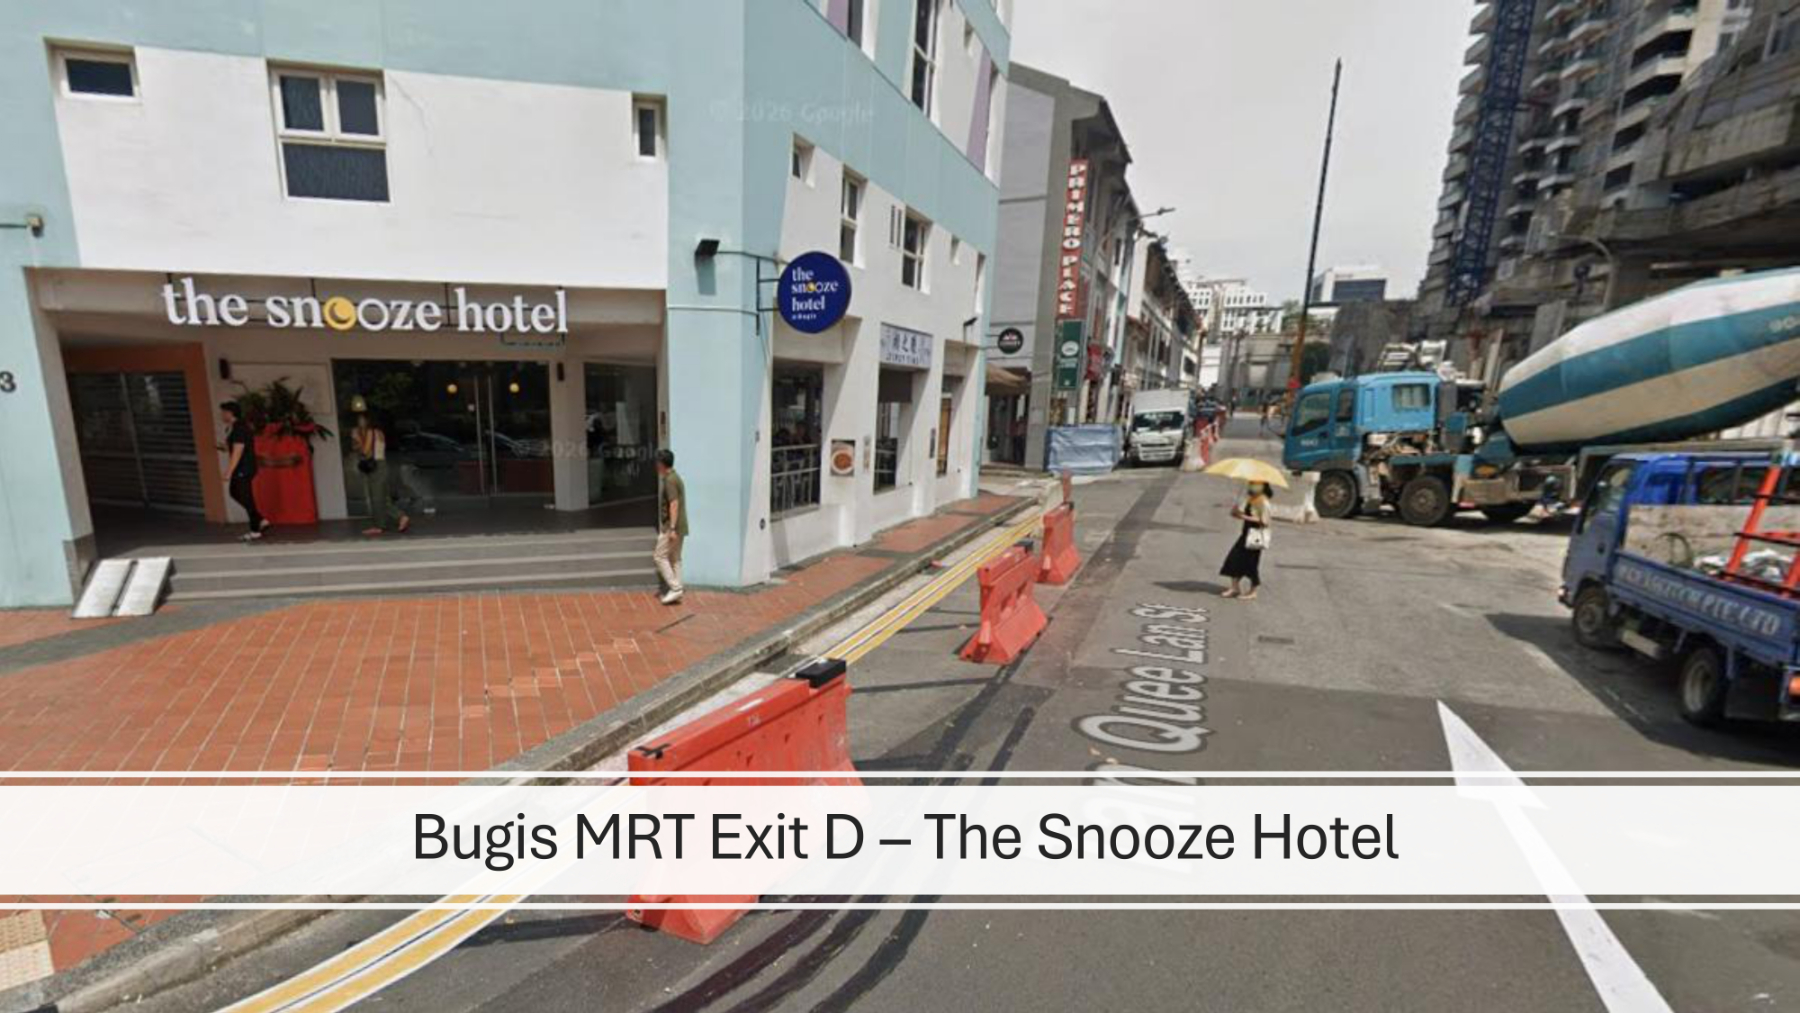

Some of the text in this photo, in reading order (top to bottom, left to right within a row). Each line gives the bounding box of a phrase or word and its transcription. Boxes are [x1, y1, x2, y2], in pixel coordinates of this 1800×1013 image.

[1058, 164, 1087, 315] PRIMERO PLACE
[792, 267, 814, 282] the
[791, 281, 839, 294] snooze
[162, 277, 569, 334] the snooze hotel
[792, 295, 825, 312] hotel
[1739, 605, 1781, 636] LTD
